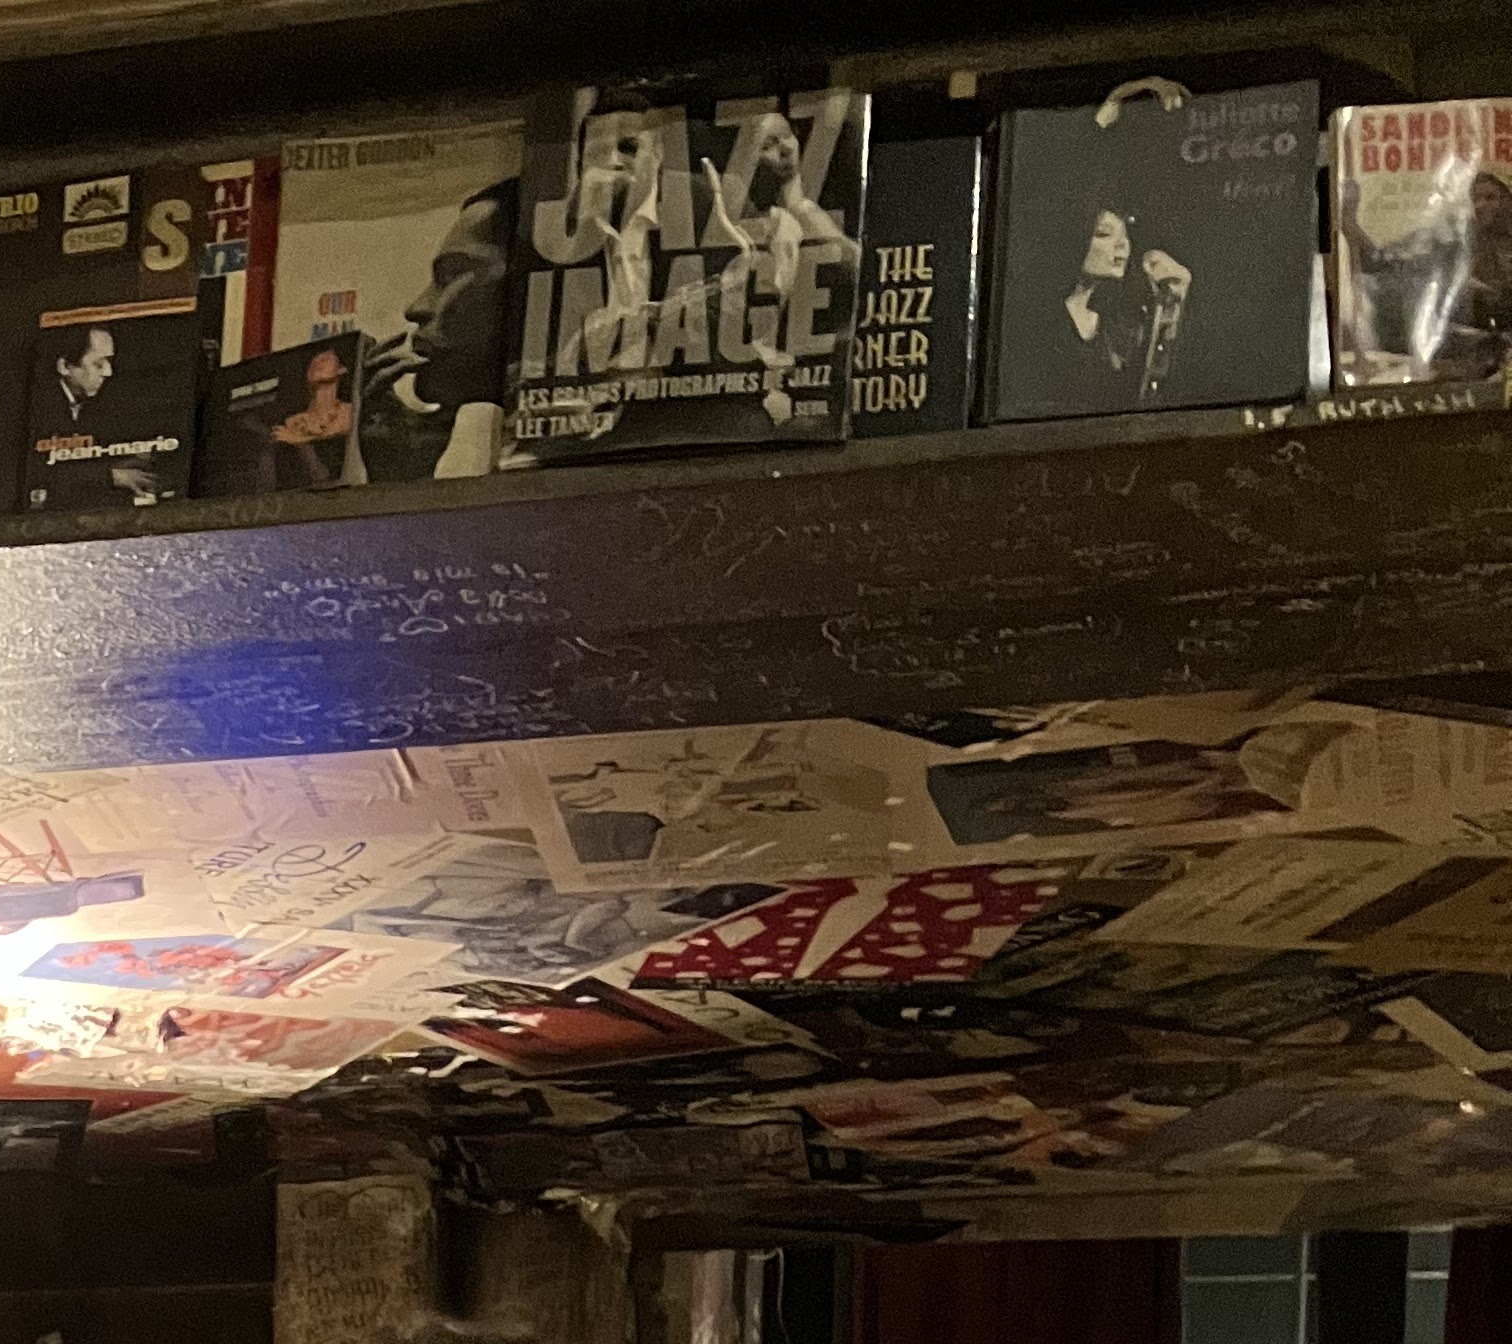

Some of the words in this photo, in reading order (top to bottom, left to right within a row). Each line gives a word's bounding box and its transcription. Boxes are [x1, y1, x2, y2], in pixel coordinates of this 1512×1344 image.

[876, 244, 935, 284] THE
[865, 286, 934, 328] JAZZ
[850, 374, 928, 414] TORY
[45, 434, 180, 465] jean-marie
